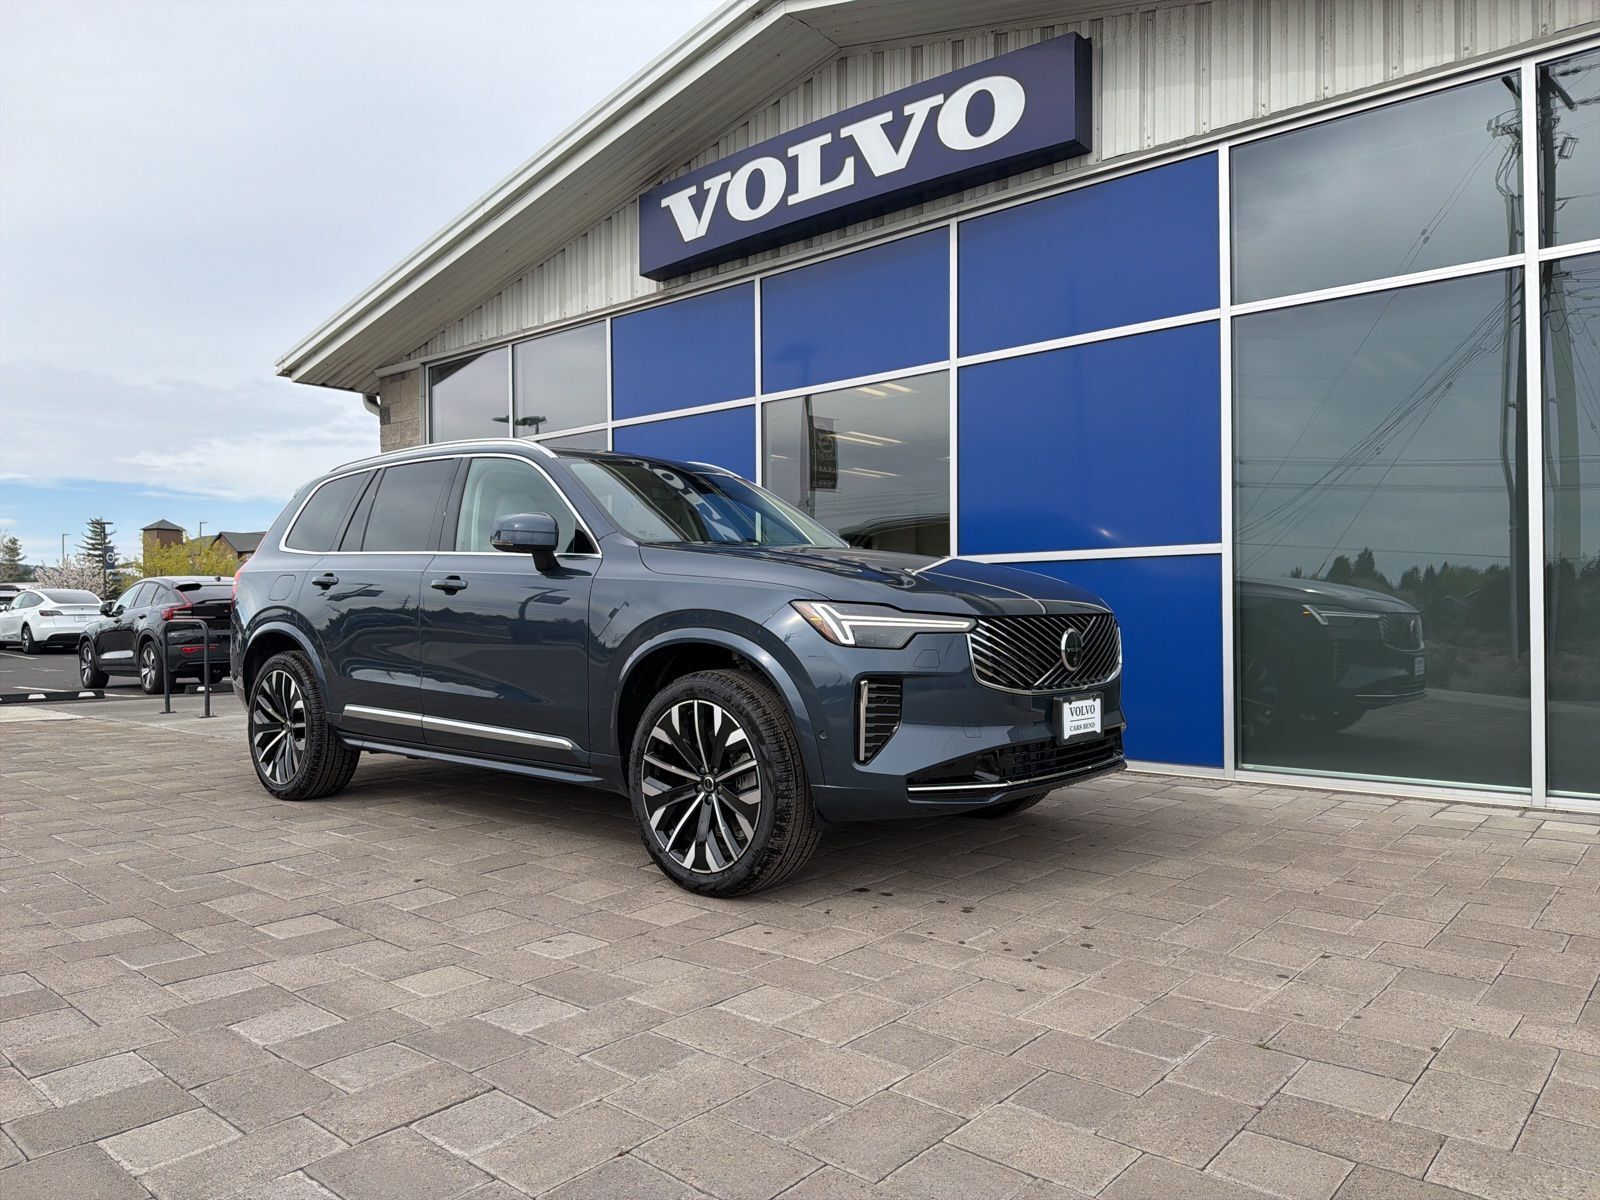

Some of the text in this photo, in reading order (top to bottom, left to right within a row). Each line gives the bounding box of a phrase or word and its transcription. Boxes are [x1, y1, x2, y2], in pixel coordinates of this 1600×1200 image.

[661, 75, 1026, 242] VOLVO
[1070, 704, 1095, 717] VOLVO
[1070, 722, 1095, 732] CARS BEND
